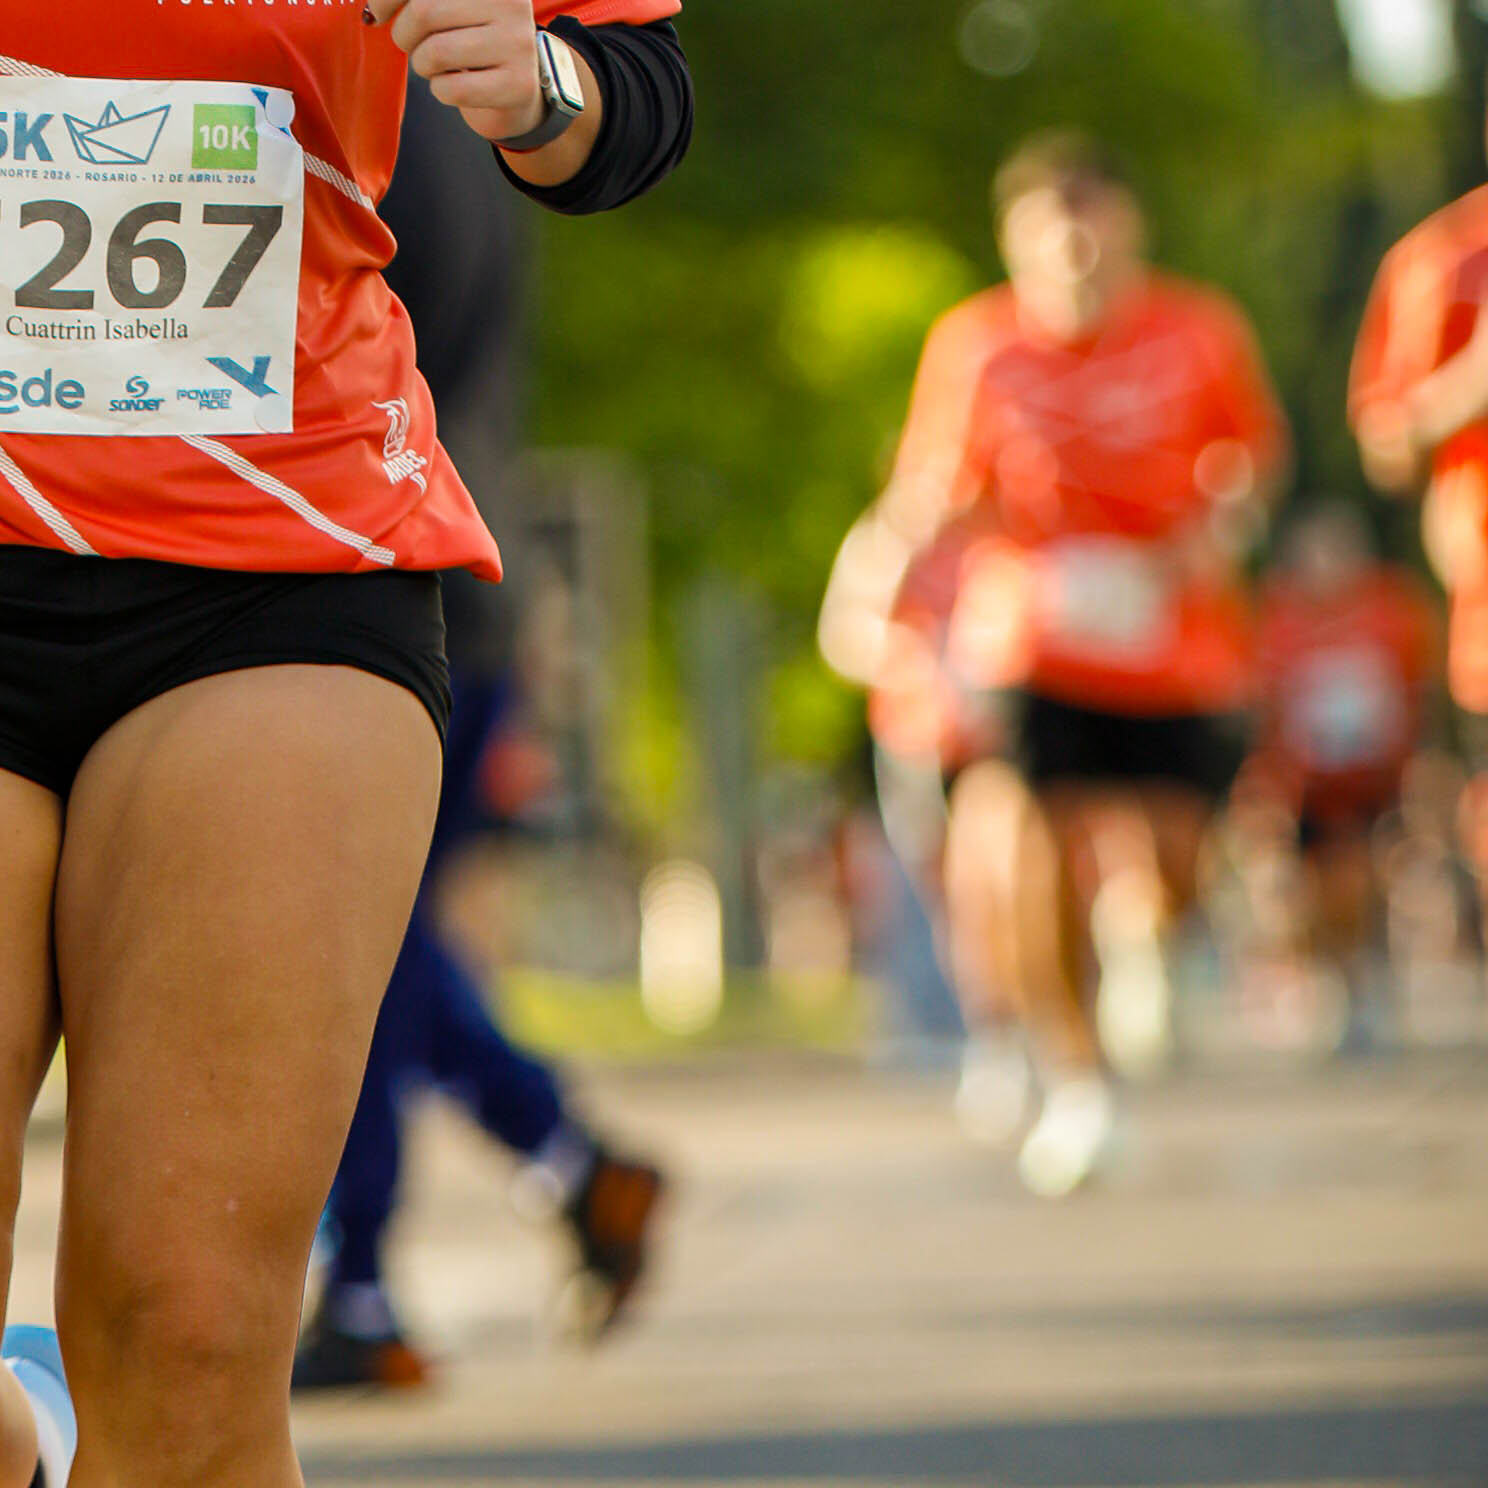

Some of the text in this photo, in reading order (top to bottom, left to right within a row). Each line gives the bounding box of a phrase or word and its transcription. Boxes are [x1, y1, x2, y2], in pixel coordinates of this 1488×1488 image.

[199, 124, 250, 151] 10K
[0, 167, 38, 179] NORTE
[85, 172, 137, 182] ROSARIO
[152, 173, 163, 183] 12
[169, 173, 183, 183] DE
[188, 174, 222, 183] ABRIL
[227, 174, 256, 184] 2026
[5, 315, 189, 340] Cuattrin Isabella
[176, 388, 232, 400] POWER
